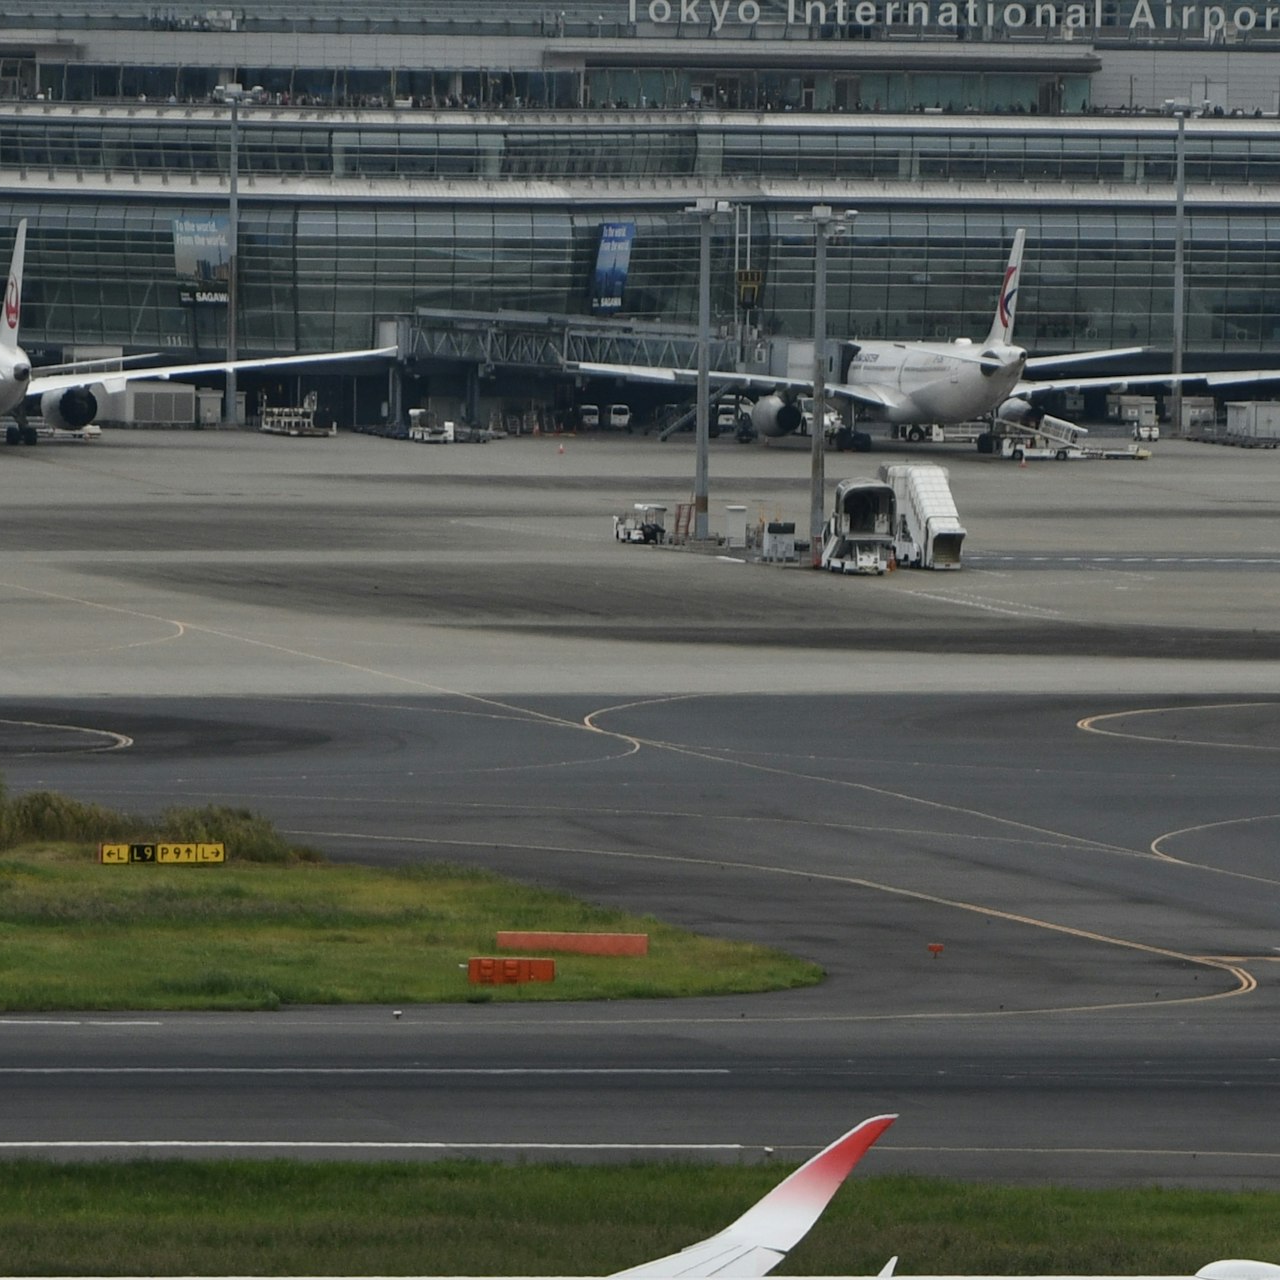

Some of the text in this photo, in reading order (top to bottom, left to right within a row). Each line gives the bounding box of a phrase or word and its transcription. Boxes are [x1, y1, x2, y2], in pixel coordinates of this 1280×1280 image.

[626, 0, 761, 31] Tokyo
[788, 0, 1103, 28] International
[195, 291, 229, 302] SAGAW
[118, 848, 124, 860] L
[202, 848, 208, 860] L
